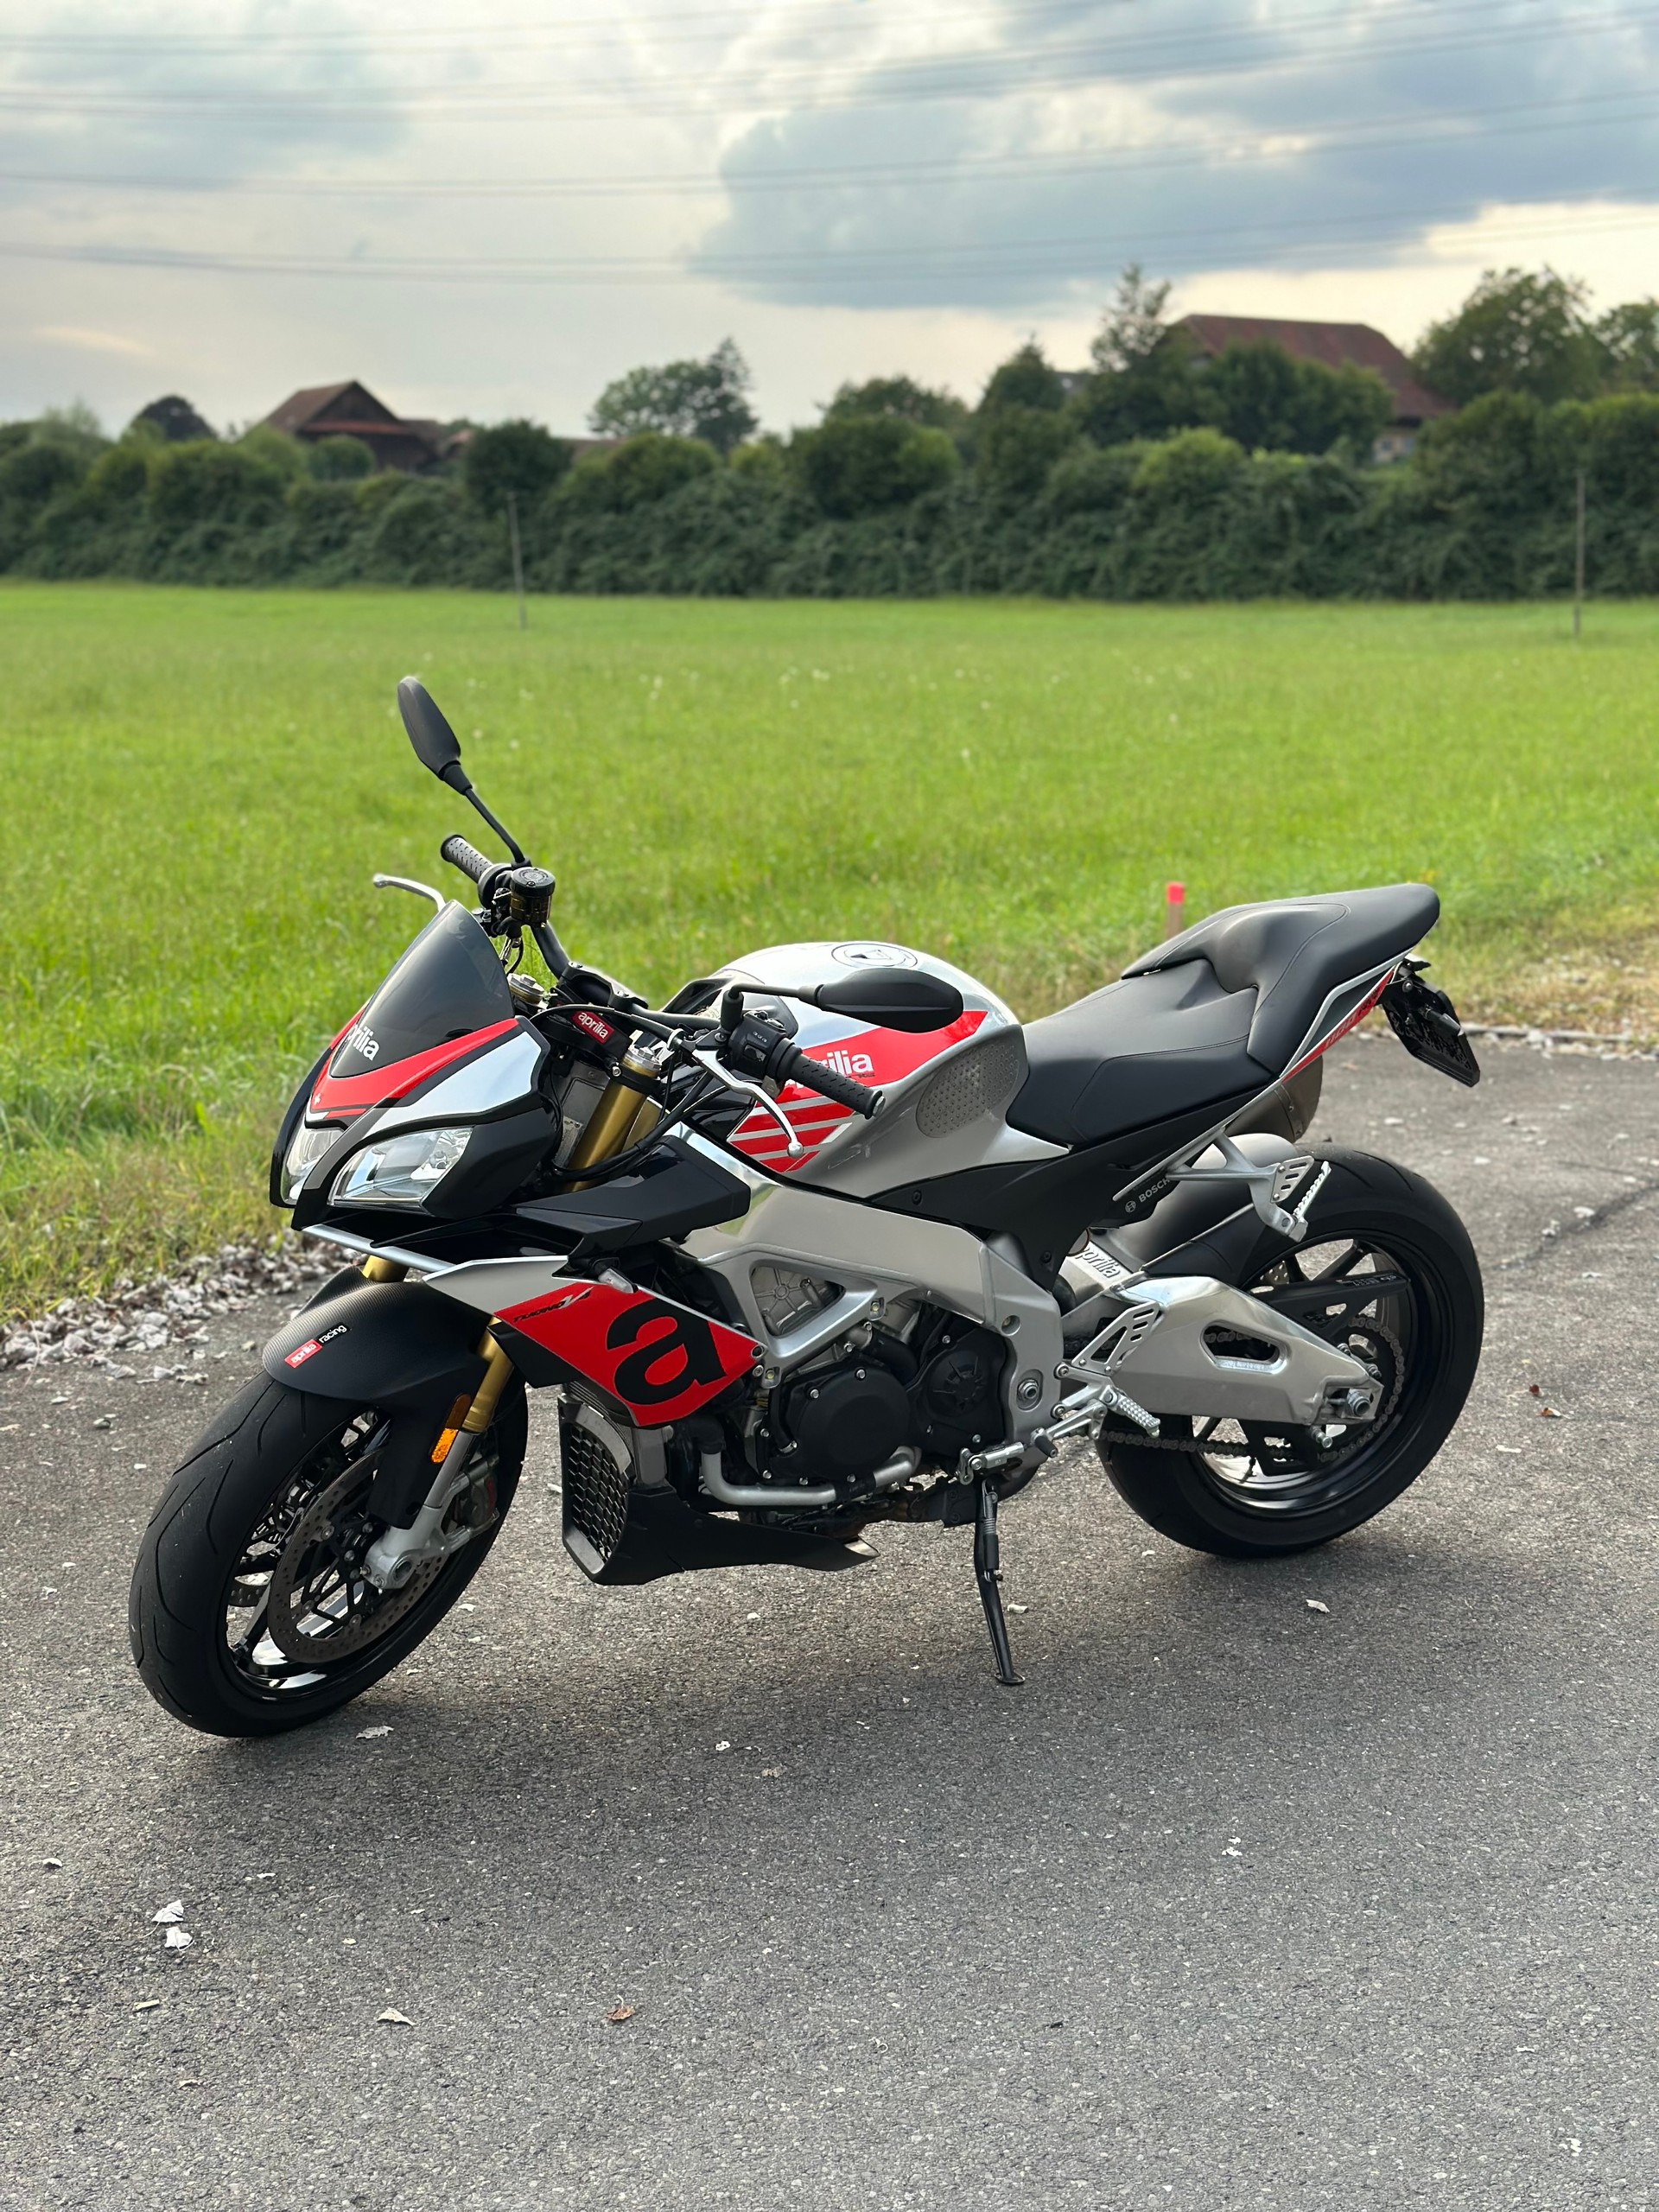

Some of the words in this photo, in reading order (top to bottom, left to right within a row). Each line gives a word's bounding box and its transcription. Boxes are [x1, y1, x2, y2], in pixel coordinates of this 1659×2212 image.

[578, 1012, 608, 1039] aprilia
[1139, 1178, 1170, 1203] BOSCH
[290, 1344, 317, 1363] aprilia
[319, 1325, 347, 1344] racing
[607, 1298, 727, 1405] a
